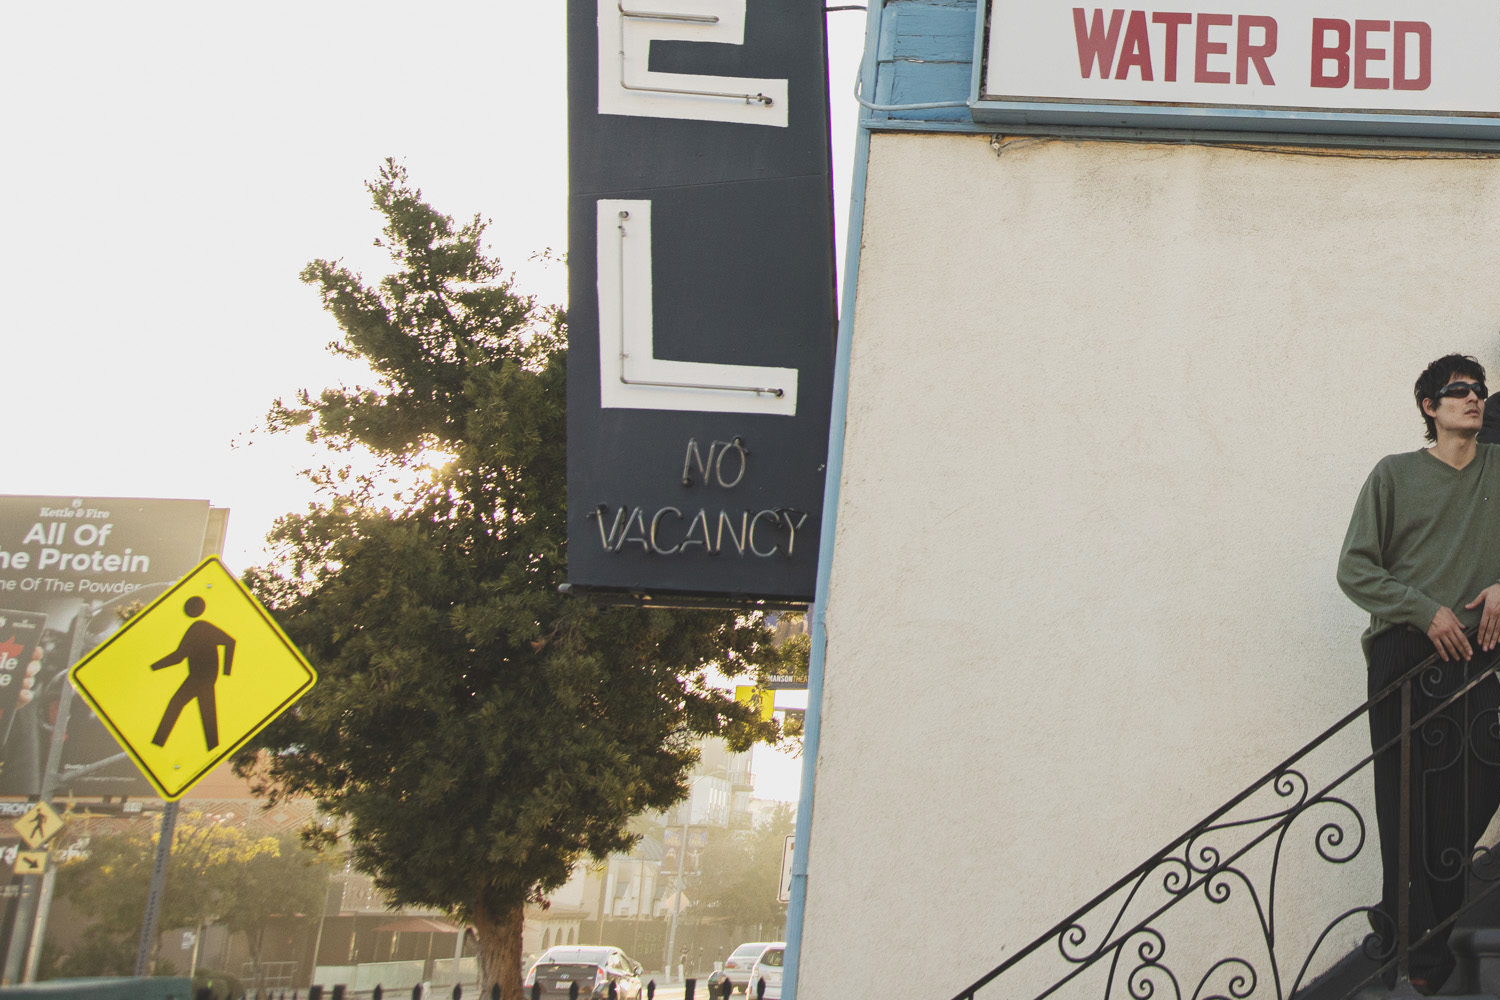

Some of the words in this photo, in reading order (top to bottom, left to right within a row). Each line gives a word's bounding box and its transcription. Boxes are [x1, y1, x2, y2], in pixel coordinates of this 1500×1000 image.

[1072, 7, 1278, 86] WATER
[1310, 17, 1432, 91] BED
[682, 437, 746, 488] NO
[40, 507, 74, 518] Kettle
[75, 508, 84, 518] &
[86, 508, 110, 518] Fire
[22, 522, 66, 545] All
[74, 523, 114, 546] Of
[596, 506, 808, 557] VACANCY
[38, 548, 150, 573] Protein
[20, 578, 42, 592] Of
[45, 578, 74, 592] The
[78, 579, 141, 594] Powder
